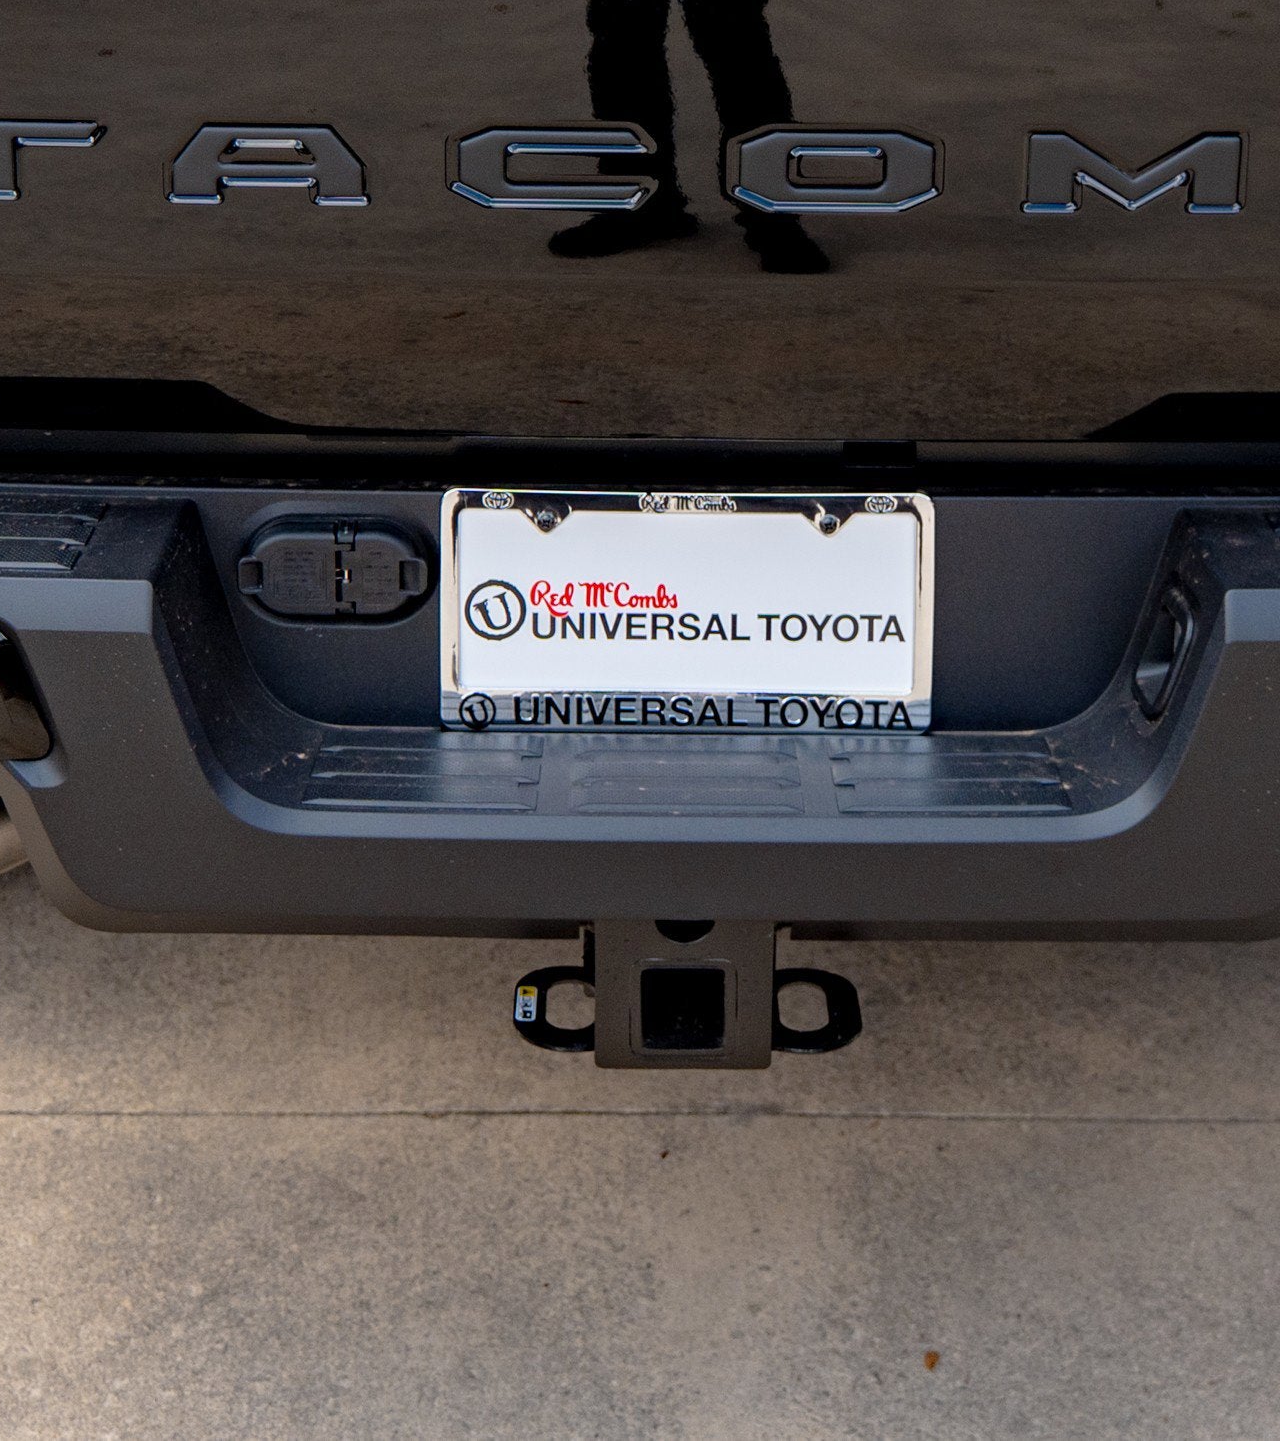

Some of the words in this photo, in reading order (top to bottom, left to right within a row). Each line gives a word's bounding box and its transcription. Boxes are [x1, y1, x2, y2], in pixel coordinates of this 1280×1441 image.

[640, 493, 668, 513] Red
[673, 494, 737, 512] McCombs
[530, 580, 574, 617] Red
[578, 581, 679, 609] McCombs
[531, 612, 750, 642] UNIVERSAL
[758, 613, 906, 643] TOYOTA
[513, 693, 749, 727] UNIVERSAL
[755, 696, 913, 730] TOYOTA
